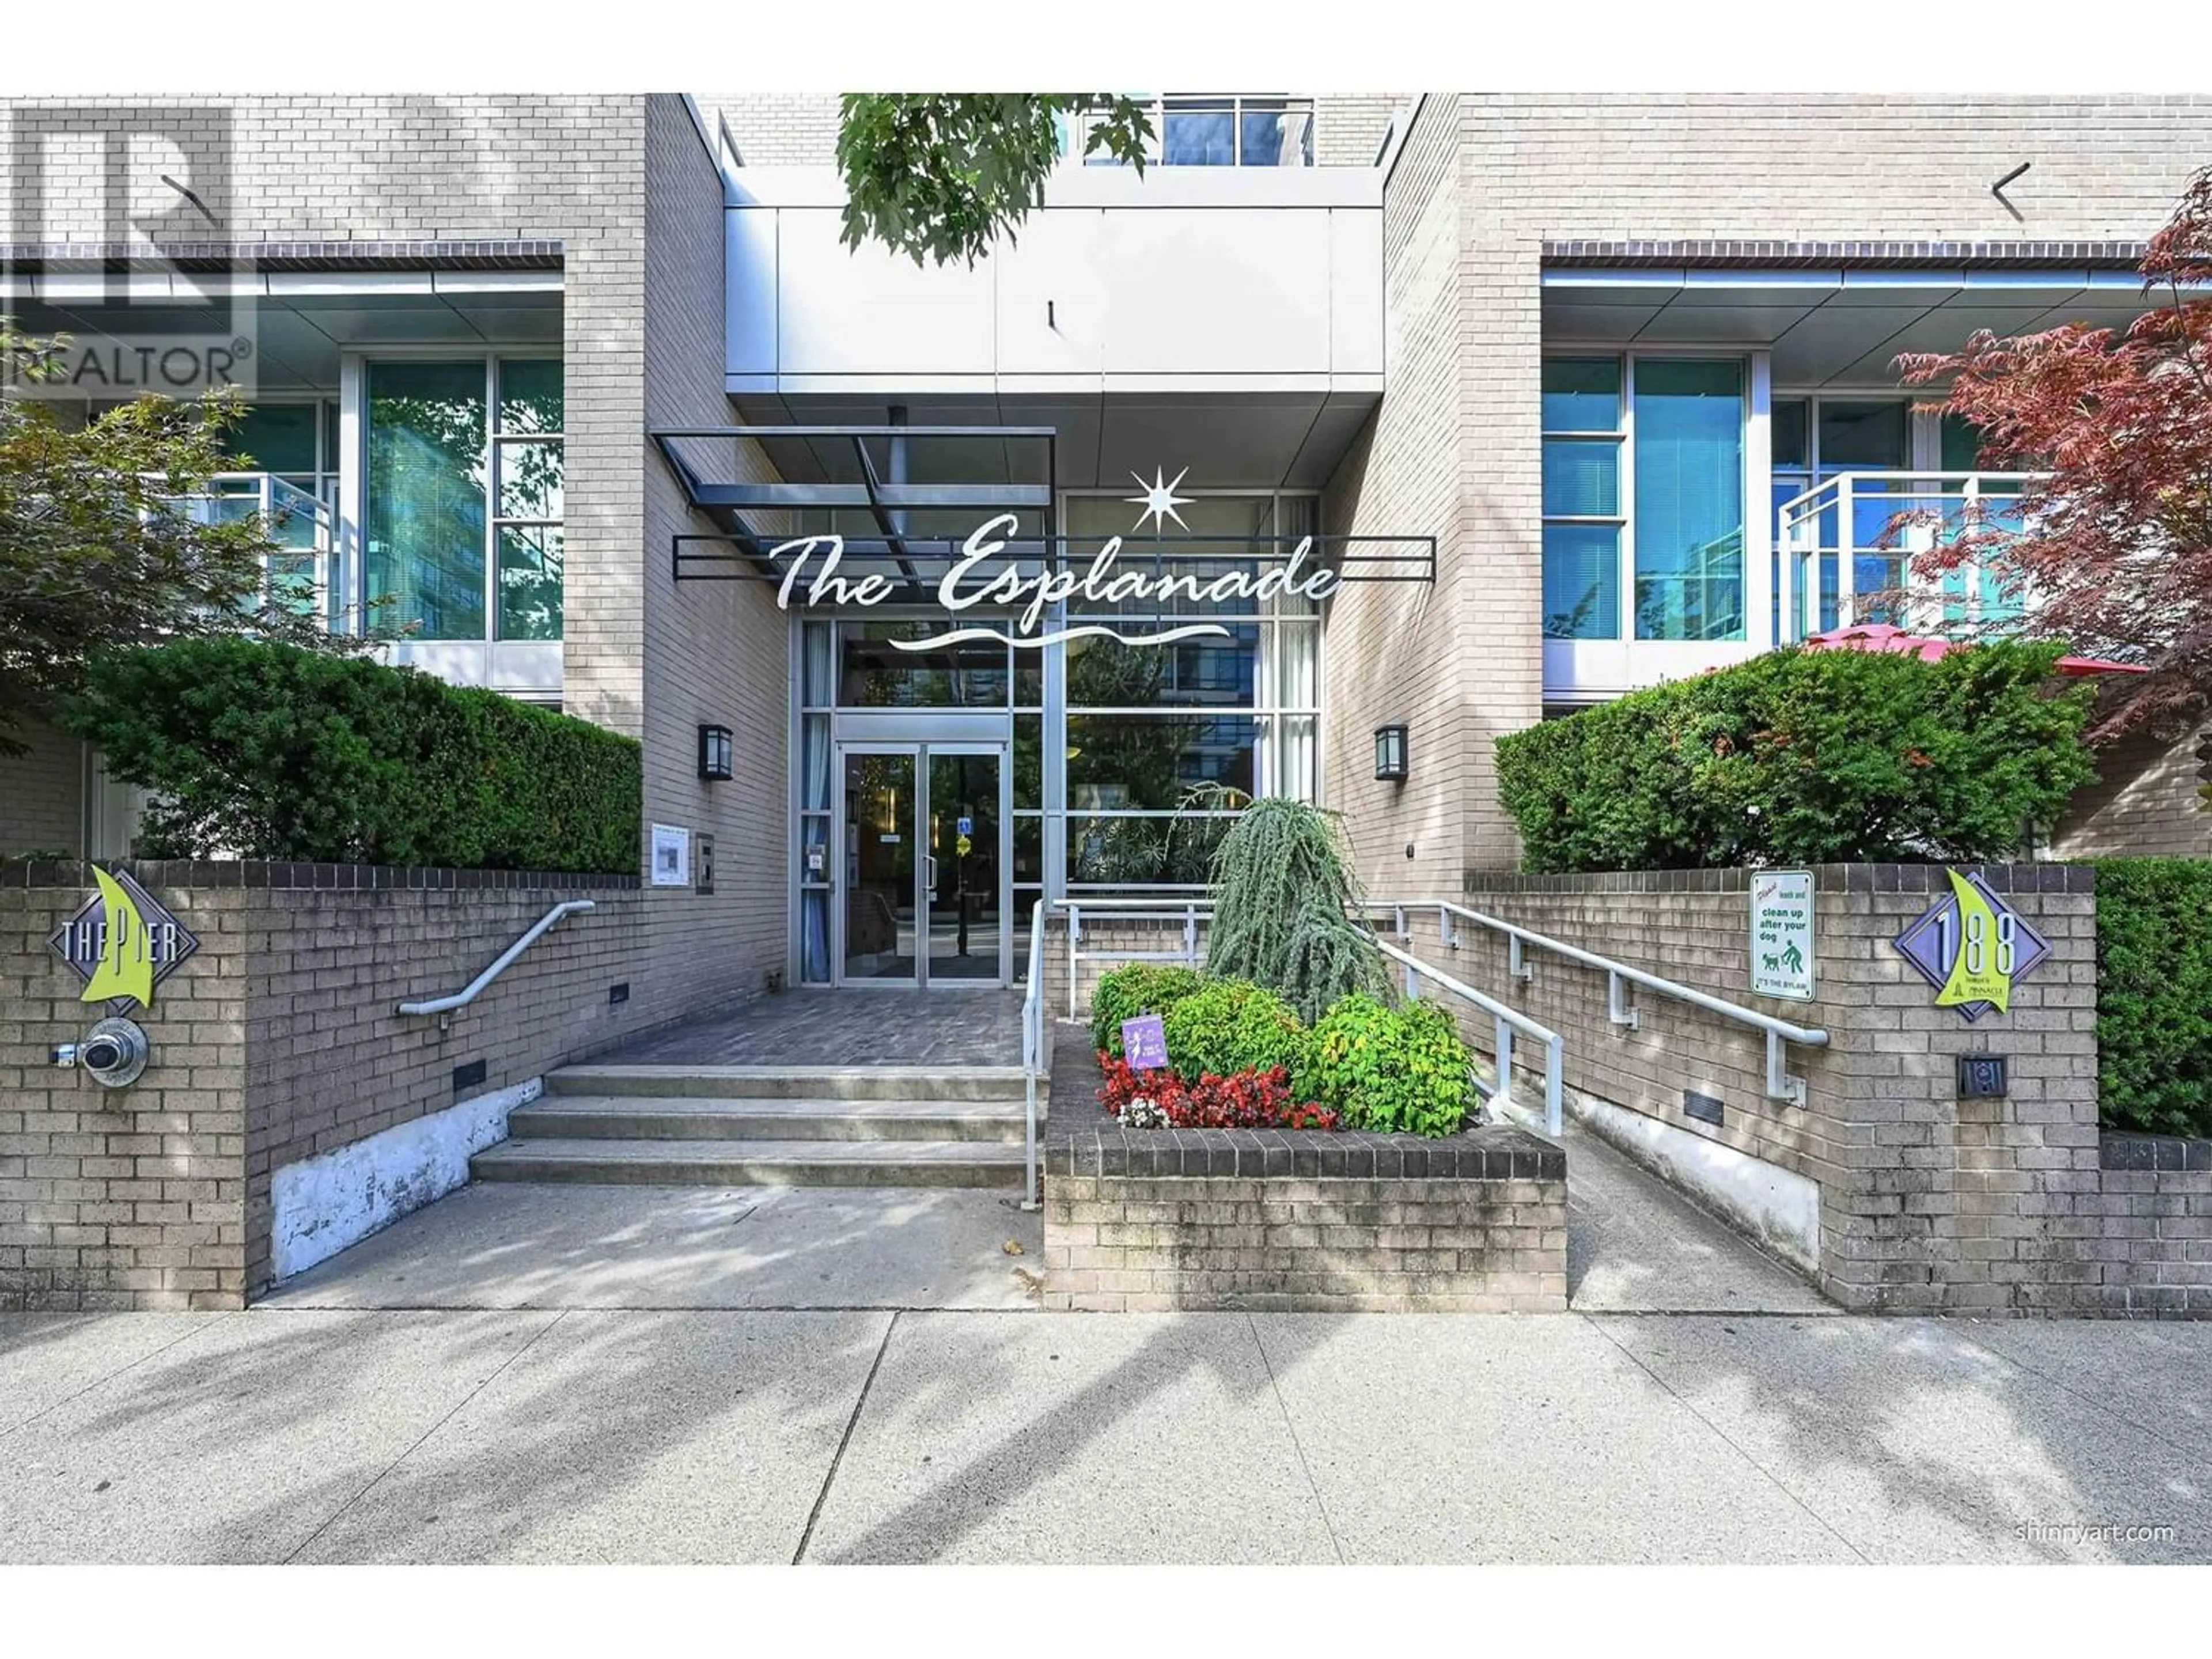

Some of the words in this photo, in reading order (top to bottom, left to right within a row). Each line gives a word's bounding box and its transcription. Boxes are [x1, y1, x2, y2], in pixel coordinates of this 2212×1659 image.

[768, 535, 892, 612] The
[937, 513, 1344, 634] Esplanade
[1762, 907, 1788, 917] clean
[1790, 909, 1804, 919] up
[1759, 919, 1782, 928] after
[1785, 921, 1806, 931] your
[1759, 931, 1777, 943] dog
[1937, 911, 2016, 975] 188
